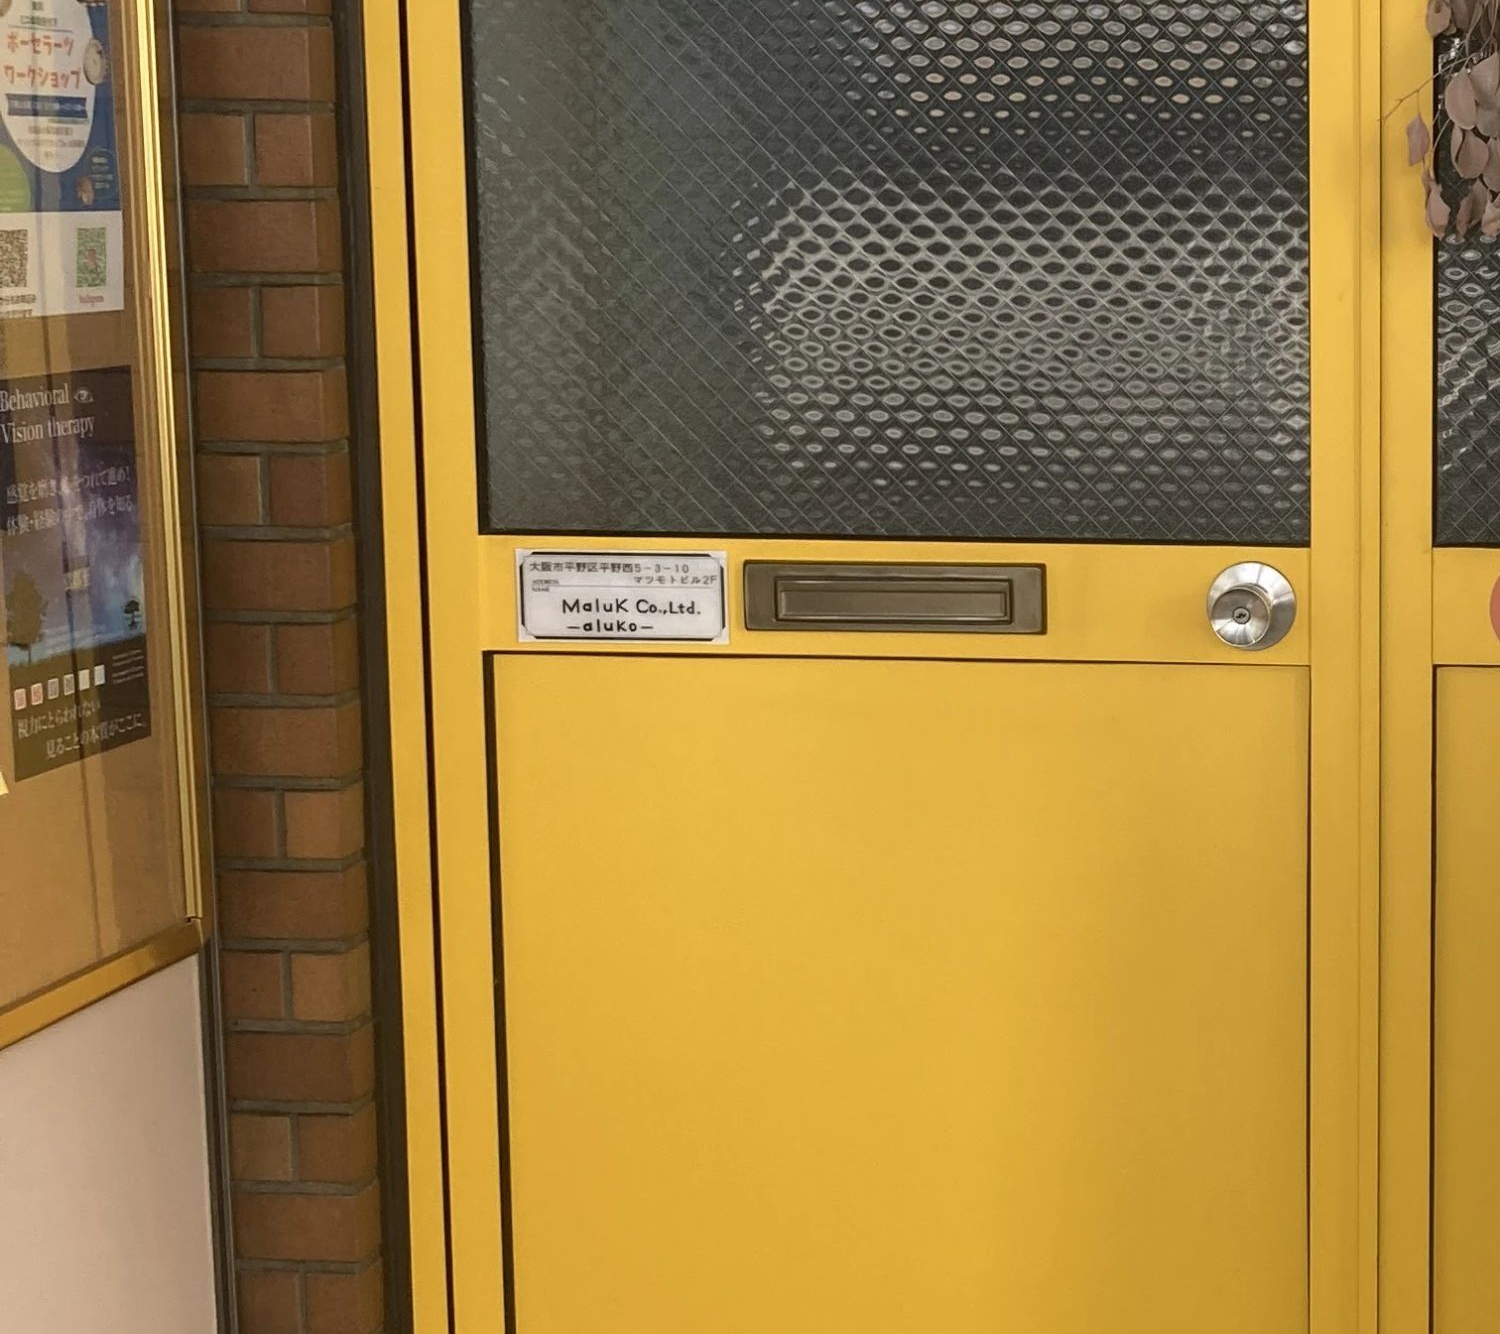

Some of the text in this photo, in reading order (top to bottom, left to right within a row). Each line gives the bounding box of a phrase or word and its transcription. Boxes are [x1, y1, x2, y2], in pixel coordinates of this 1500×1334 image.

[0, 383, 69, 412] Behavioral
[1, 416, 96, 444] Vision therapy
[634, 575, 718, 585] マツモトビル2F
